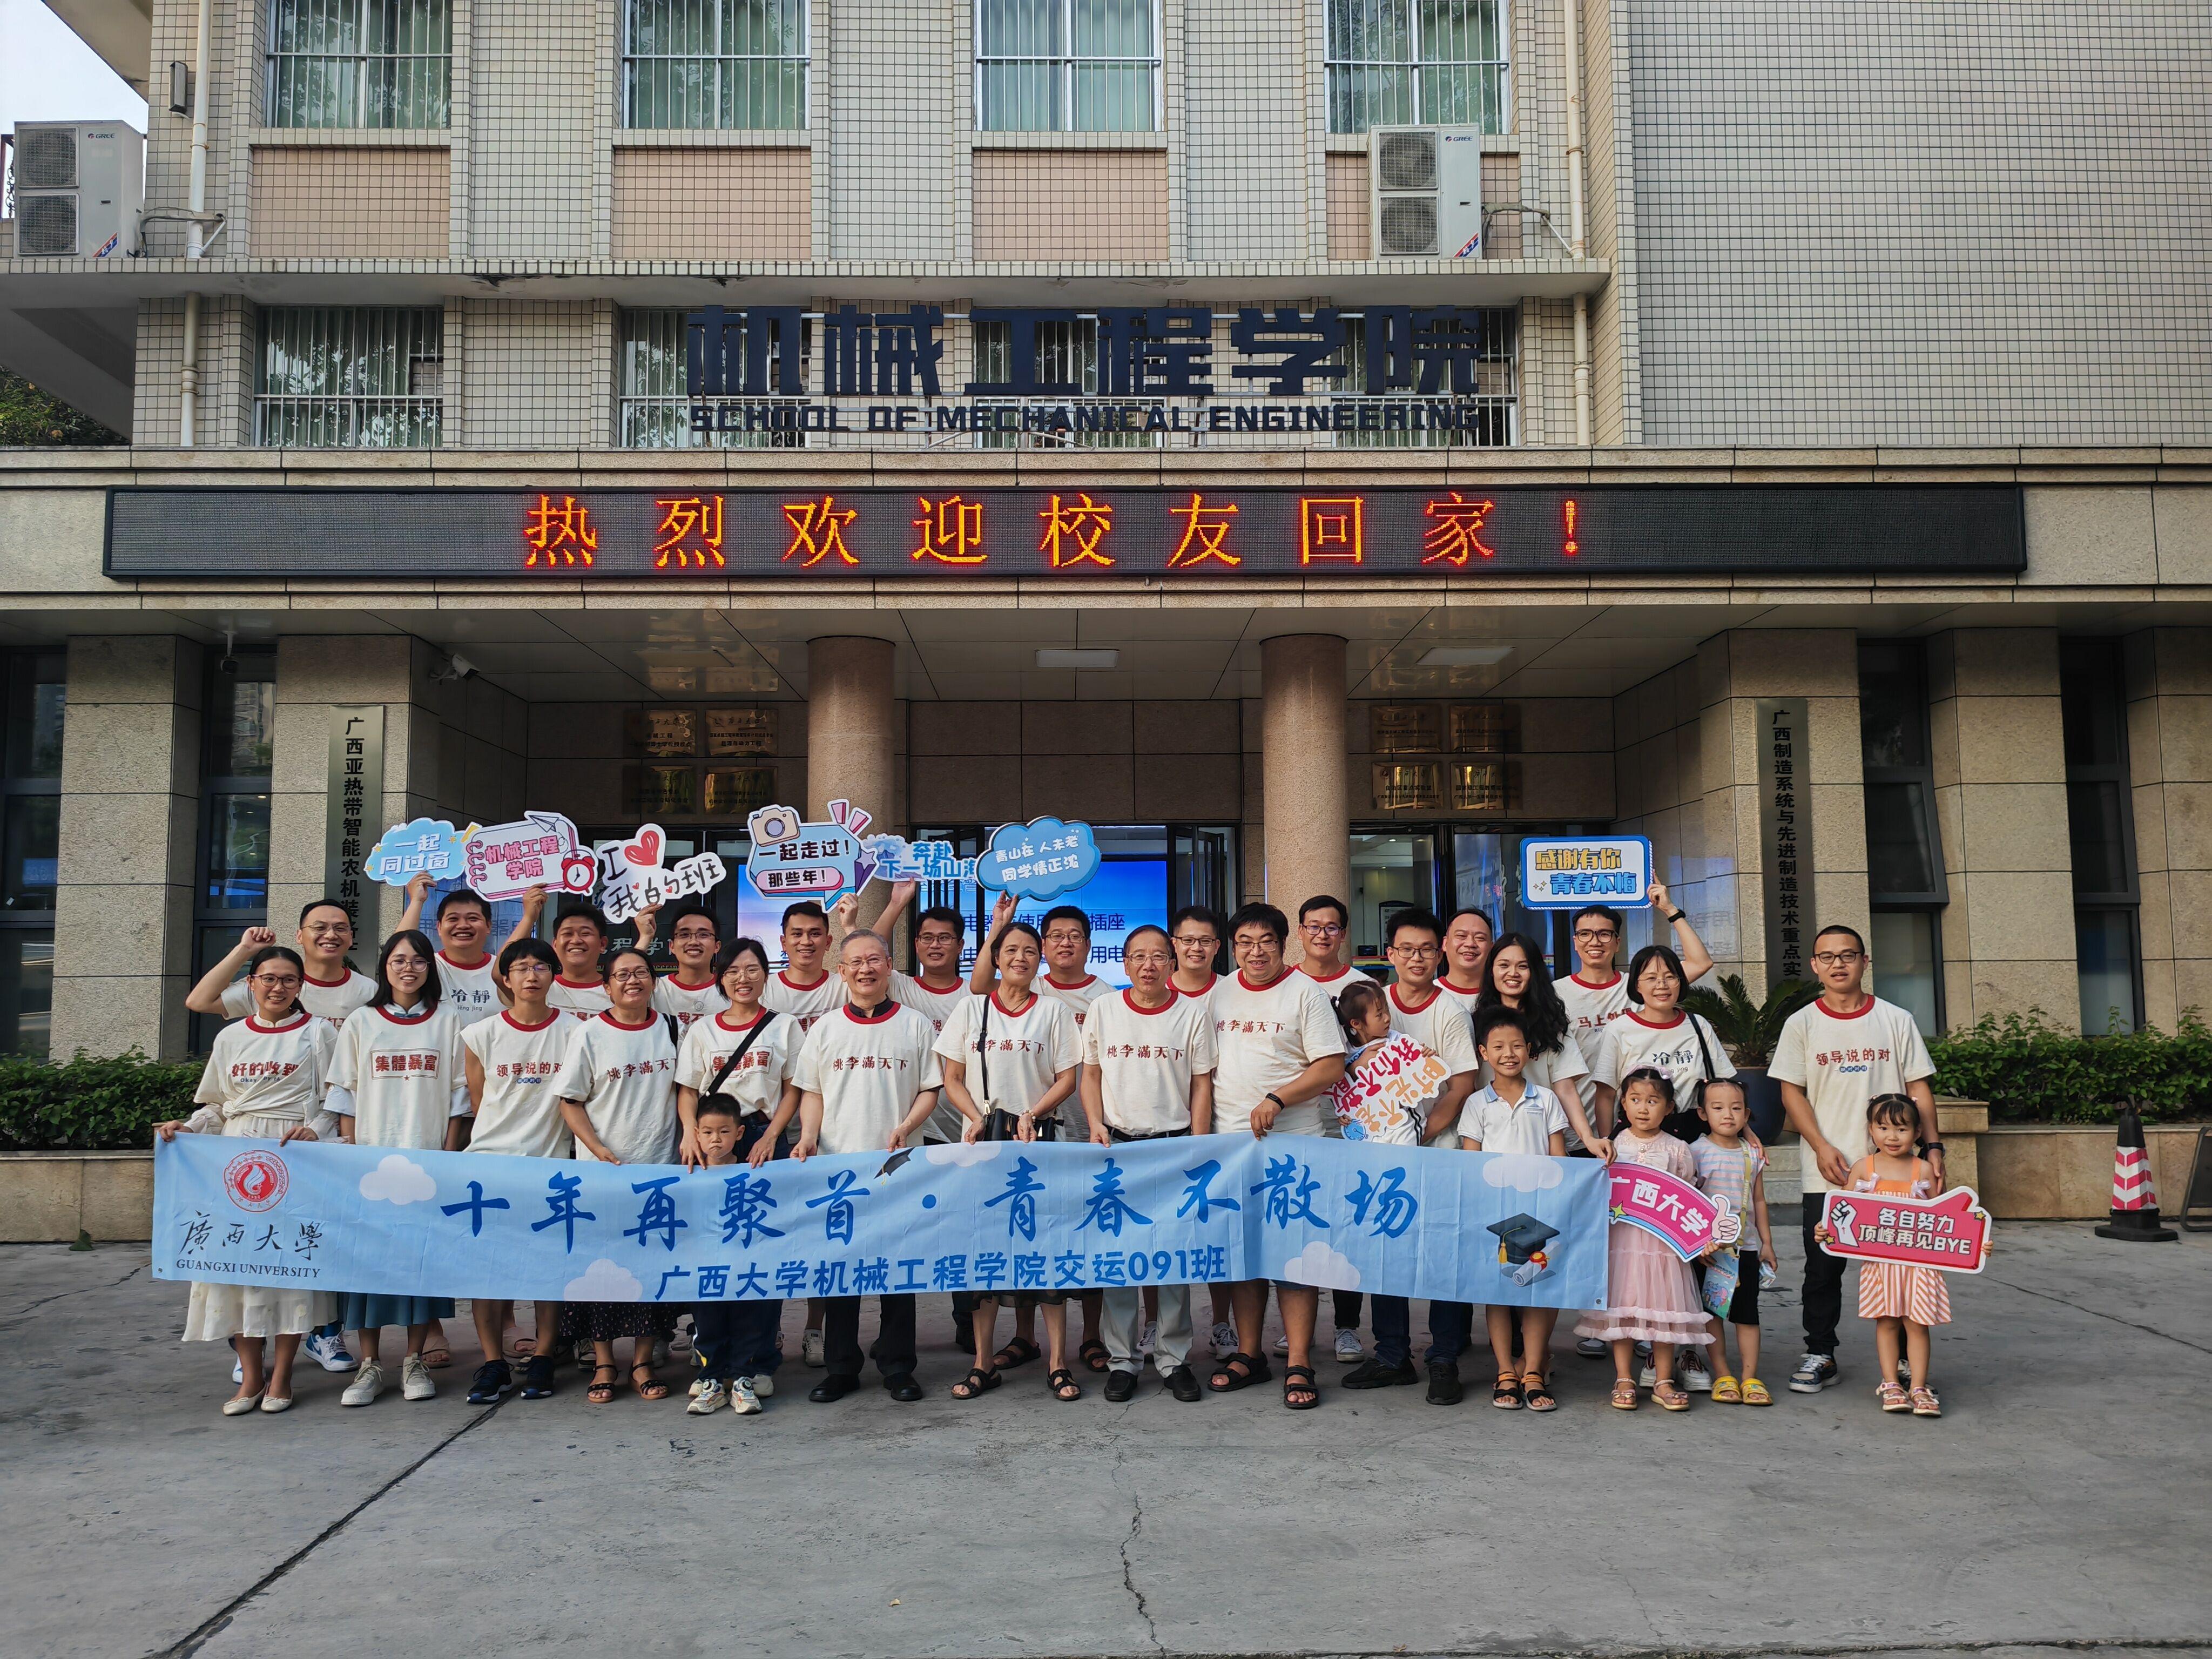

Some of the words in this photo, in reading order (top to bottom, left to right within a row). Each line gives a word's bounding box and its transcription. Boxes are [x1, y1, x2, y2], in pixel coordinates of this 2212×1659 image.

[686, 305, 1480, 395] 机械工程学院
[690, 404, 850, 433] SCHOOL
[868, 405, 918, 433] OF
[944, 405, 1191, 433] MECHANICAL
[1208, 405, 1479, 432] ENGINEERING
[340, 716, 365, 951] 广西亚热带智能农机装
[395, 833, 441, 850] 一起
[1772, 710, 1802, 976] 广西制造系统与先进制造技术重点实
[379, 851, 450, 875] 同过窗
[485, 835, 559, 863] 机械工程
[602, 846, 628, 881] I
[913, 842, 952, 861] 奔赴
[995, 843, 1035, 864] 青山在
[1038, 834, 1081, 855] 人未老
[1535, 847, 1622, 871] 感谢有你
[506, 857, 544, 880] 学院
[1001, 853, 1081, 883] 同学情正浓
[1816, 1048, 1892, 1066] 领导说的对
[1879, 1206, 1955, 1235] 各自努力
[1859, 1224, 1972, 1255] 顶峰再见BYE
[176, 1259, 237, 1273] GUANGXI
[239, 1263, 321, 1278] UNIVERSITY
[655, 1244, 1226, 1301] 广西大学机械工程学院交运091班
